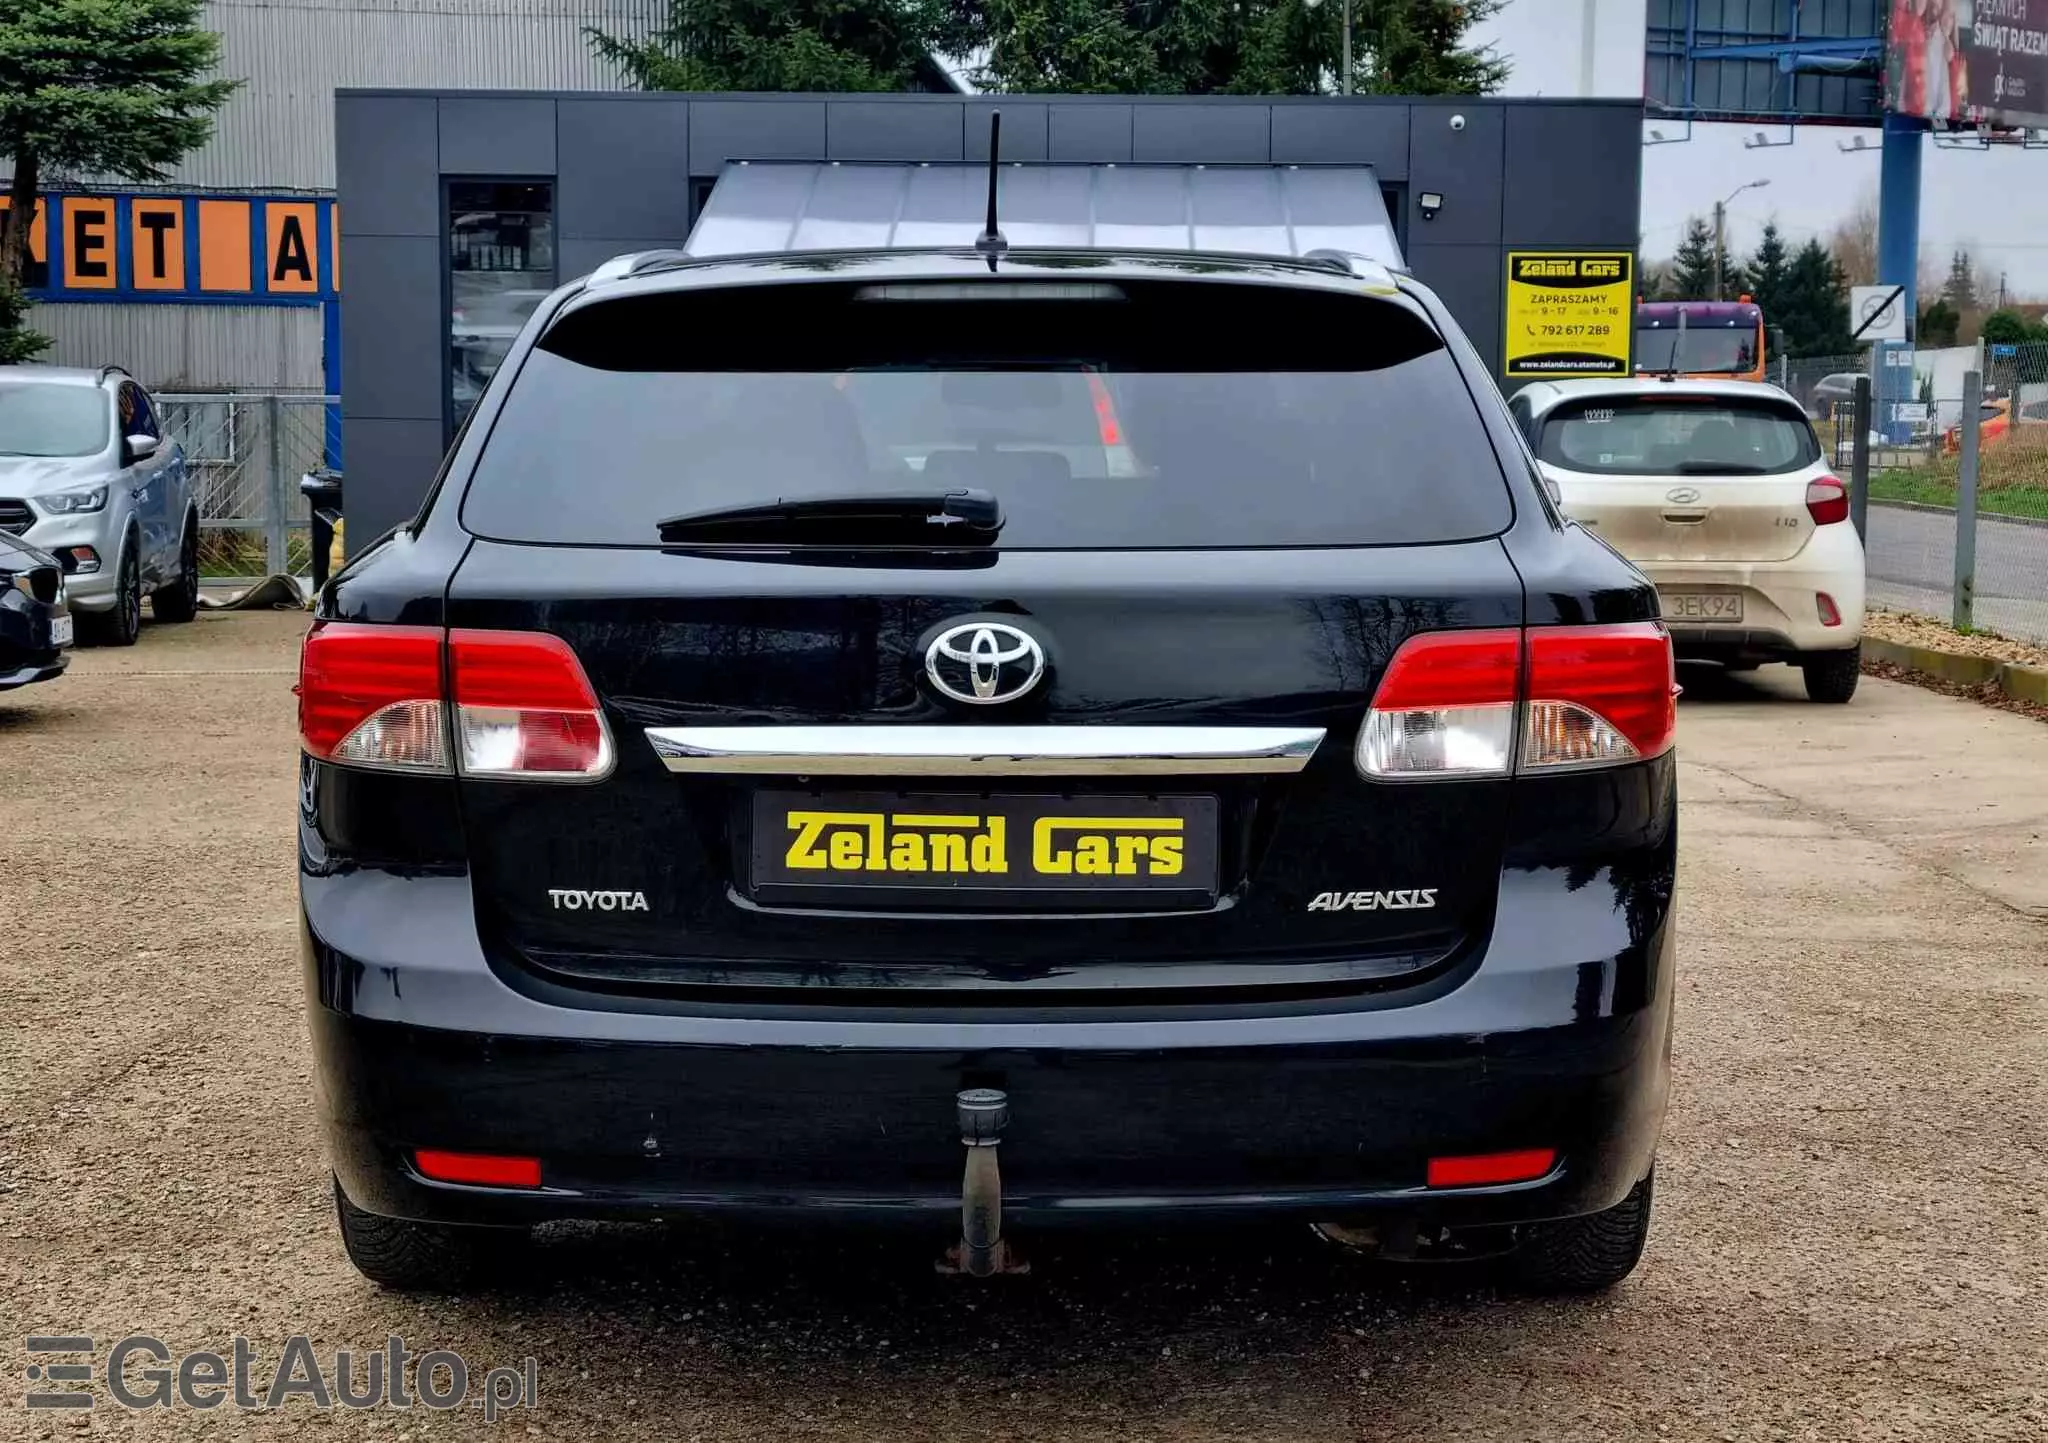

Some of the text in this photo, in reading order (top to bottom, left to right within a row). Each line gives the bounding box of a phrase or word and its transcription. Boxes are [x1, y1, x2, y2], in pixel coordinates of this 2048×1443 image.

[1975, 15, 2048, 56] ŚWIĄT RAZEM
[1520, 260, 1620, 276] Zeland Cars
[1531, 295, 1608, 304] ZAPRASZAMY
[1541, 325, 1610, 335] 792 617 289
[1673, 597, 1738, 616] 3EK94
[785, 811, 1184, 875] Zeland Cars
[548, 889, 650, 911] TOYOTA
[1307, 888, 1439, 912] AVENSIS
